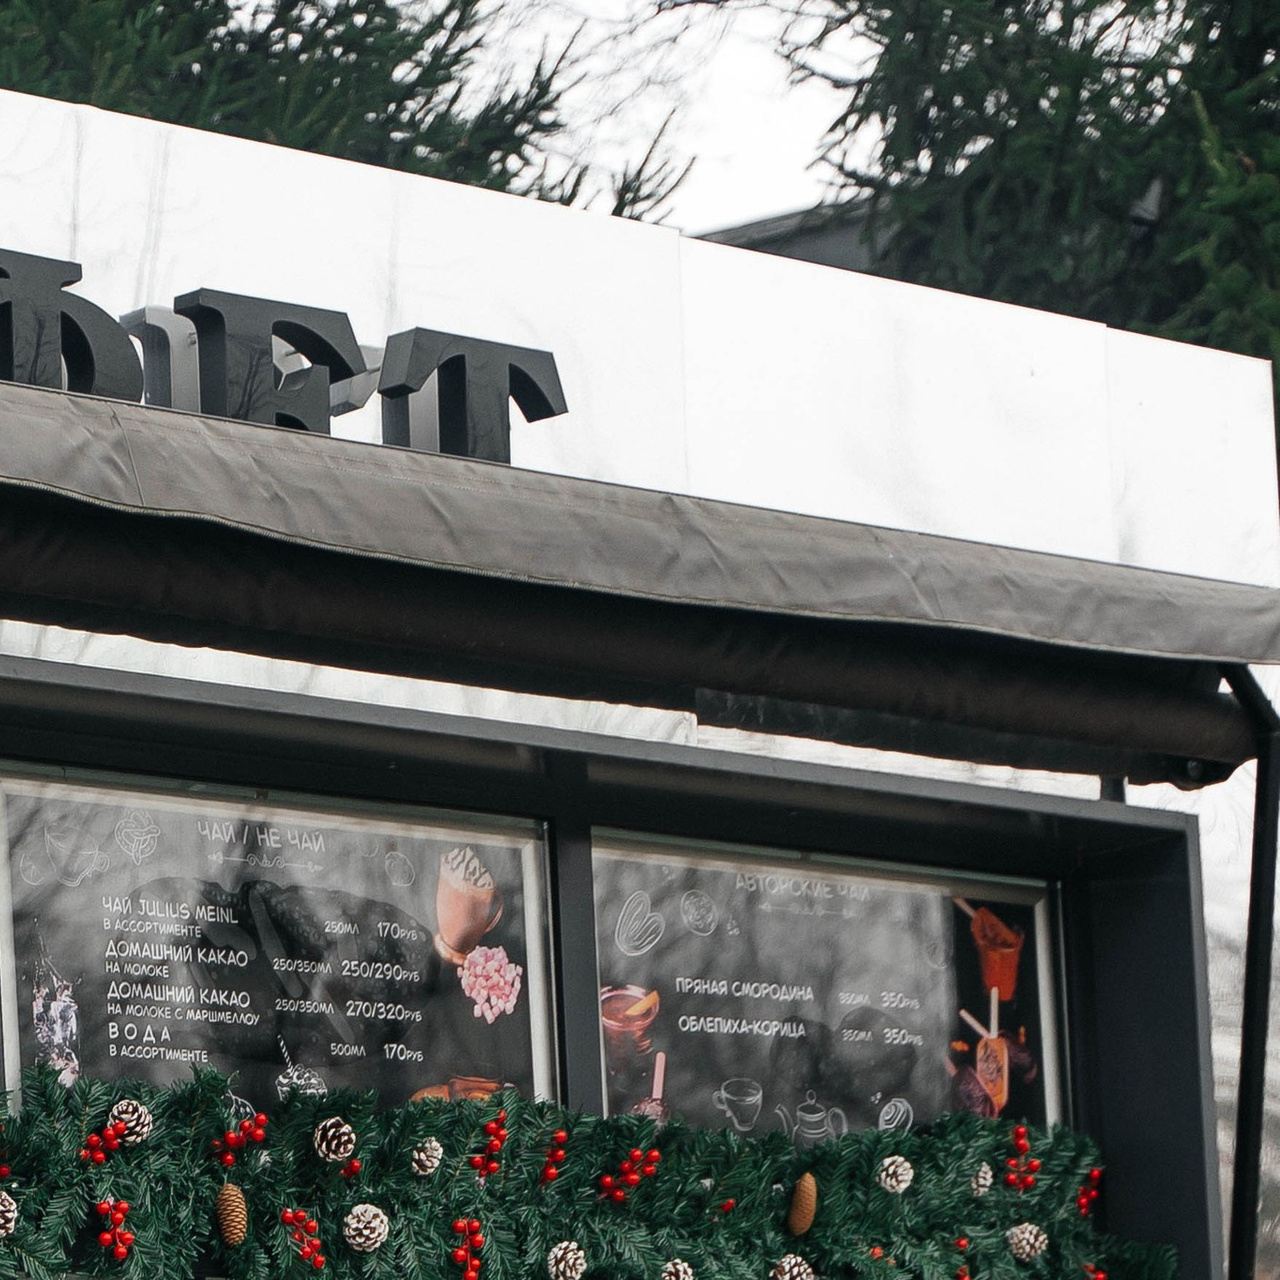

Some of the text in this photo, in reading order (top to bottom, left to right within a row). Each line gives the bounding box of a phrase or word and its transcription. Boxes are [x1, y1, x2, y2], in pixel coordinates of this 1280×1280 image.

[197, 820, 236, 844] ЧАЙ
[256, 826, 282, 848] НЕ
[287, 829, 326, 853] ЧАЙ
[102, 896, 418, 941] ЧАЙ JULIUS MEINL 250МЛ 170РУБ
[103, 918, 202, 938] В АССОРТИМЕНТЕ
[105, 939, 420, 982] ДОМАШНИЙ КАКАО 250/350МЛ 250/290РУБ
[105, 961, 169, 978] НА МОЛОКЕ
[107, 980, 422, 1022] ДОМАШНИЙ КАКАО 250/350МЛ 270/320РУБ
[676, 977, 728, 995] ПРЯНАЯ
[731, 981, 815, 1002] СМОРОДИНА
[107, 1003, 260, 1026] НА МОЛОКЕ С МАРШМЕЛЛОУ
[678, 1015, 806, 1038] ОБЛЕПИХА-КОРИЦА
[108, 1022, 424, 1062] ВОДА 500МЛ 170РУБ
[109, 1044, 208, 1063] В АССОРТИМЕНТЕ
